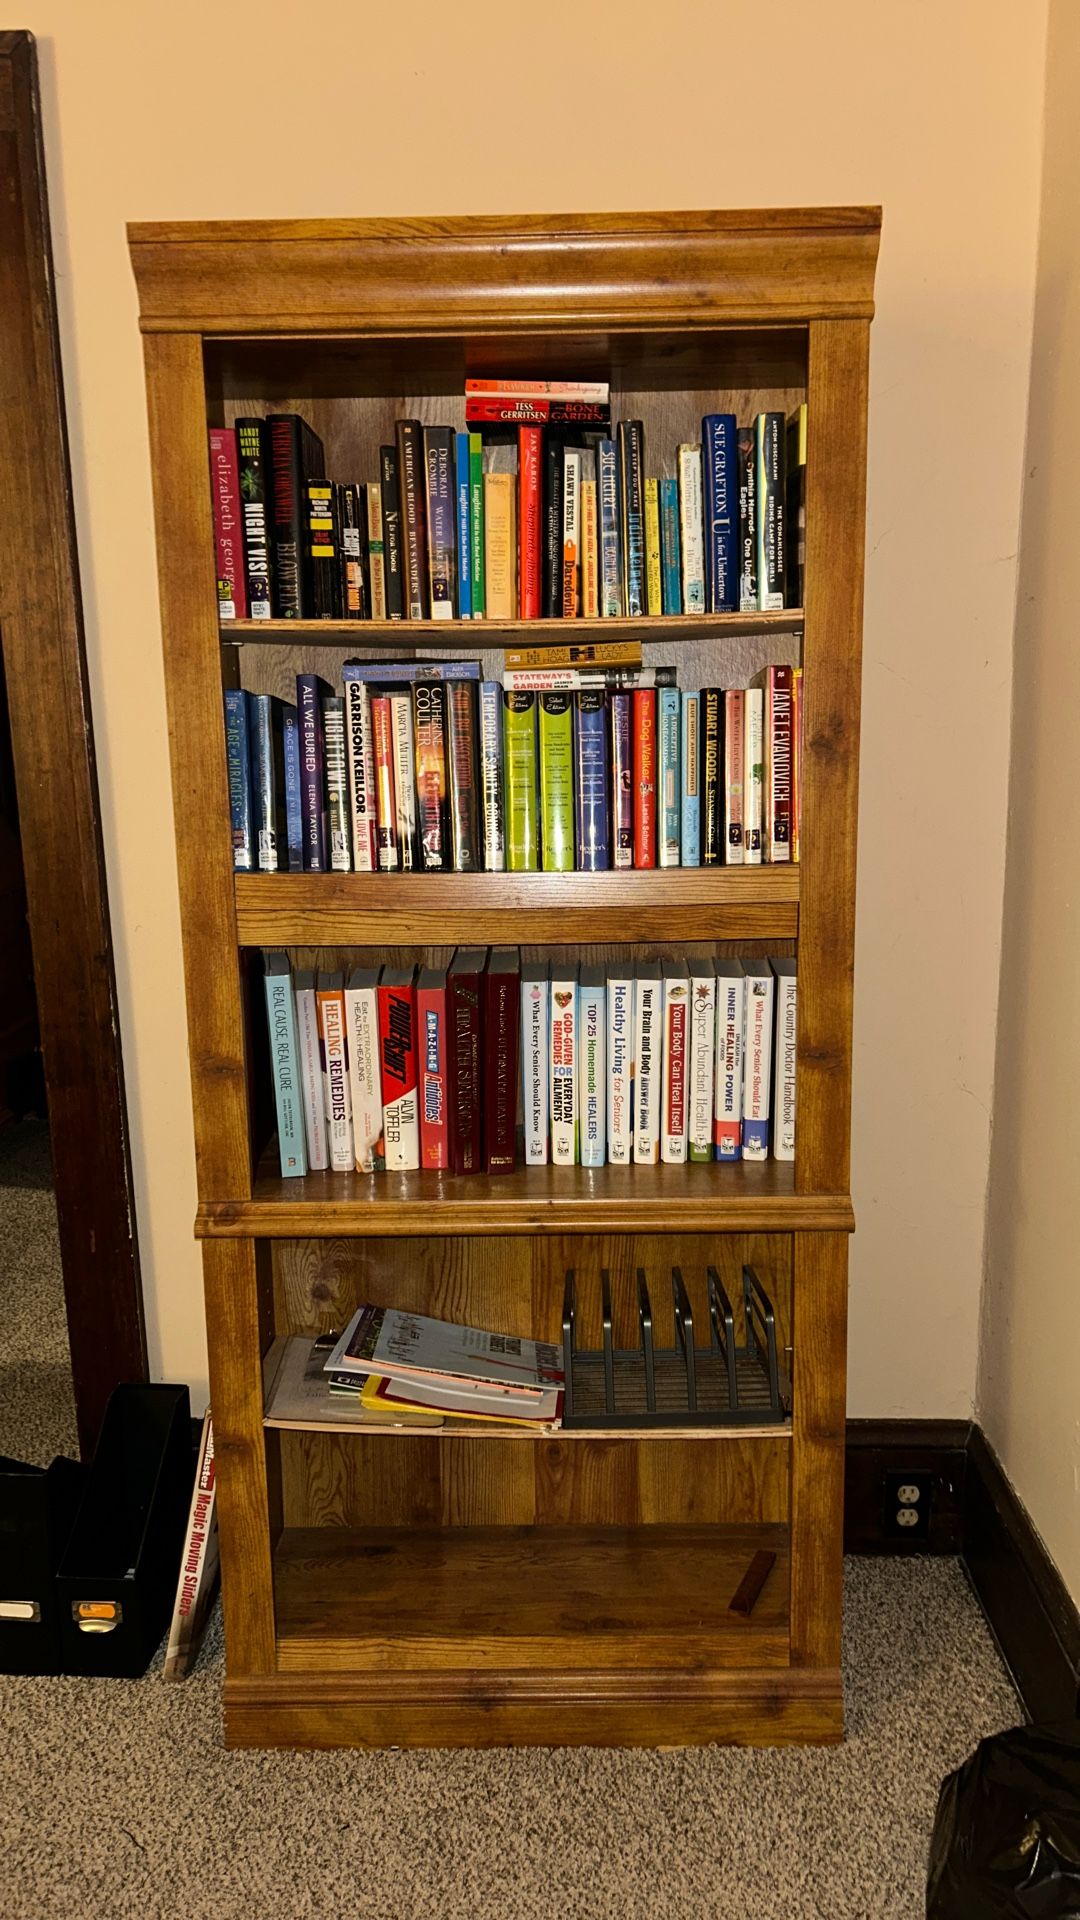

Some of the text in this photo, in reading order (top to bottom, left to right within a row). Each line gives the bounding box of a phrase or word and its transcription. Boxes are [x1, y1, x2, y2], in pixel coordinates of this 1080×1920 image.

[501, 411, 546, 419] GERRITSEN
[714, 423, 725, 449] SUE
[218, 455, 234, 530] elizabeth
[272, 422, 294, 524] PATRICIA CORNWELL
[429, 449, 438, 496] CROMBIE
[437, 448, 448, 498] DEBORAH
[603, 451, 616, 509] SUE HENRY
[715, 451, 727, 513] GRAFTON
[245, 503, 265, 544] NIGHT
[405, 440, 419, 593] AMERICAN BLOOD BEN SANDERS
[435, 506, 444, 536] WATER
[459, 484, 468, 517] Laughter
[473, 485, 481, 517] Laughter
[711, 517, 731, 534] U
[740, 486, 748, 519] Eagles
[747, 498, 755, 534] Harrod-
[386, 511, 398, 572] N NOOSE
[564, 465, 575, 616] SHAWN VESTAL Daredevils
[629, 512, 642, 547] Judith
[717, 544, 725, 556] for
[744, 538, 752, 558] One
[717, 557, 727, 600] Undertow
[416, 687, 431, 747] COULTER
[431, 687, 443, 746] CATHERINE
[640, 719, 651, 741] Dog
[641, 700, 649, 716] The
[286, 719, 294, 751] GRACE
[287, 753, 294, 763] IS
[324, 710, 346, 791] NIGHTTOWN
[397, 702, 409, 775] MARCIA MULLER
[483, 691, 497, 795] TEMPORARY SANITY
[641, 743, 651, 779] Walker
[706, 693, 717, 783] STUART WOODS
[773, 688, 790, 801] JANET EVANOVICH
[227, 728, 241, 807] AGE MIRACLES
[302, 685, 318, 845] ALL WE BURIED ELENA TAYLOR
[350, 682, 369, 852] GARRISON KEILLOR LOVE ME
[642, 826, 650, 850] Schnur
[272, 986, 286, 1010] REAL
[274, 1010, 288, 1041] CAUSE,
[325, 1003, 341, 1056] HEALING
[354, 1002, 365, 1082] HEALTH HEALING
[361, 1001, 373, 1096] Eat EXTRAORDINARY
[456, 1008, 471, 1067] HEALTH
[553, 1020, 563, 1065] REMEDIES
[563, 1013, 573, 1065] GOD-GIVEN
[725, 987, 736, 1112] INNER HEALING POWER
[277, 1043, 289, 1065] REAL
[279, 1067, 292, 1091] CURE
[530, 1001, 542, 1132] What Every Senior Should Know
[553, 1066, 573, 1076] FOR
[587, 1004, 597, 1140] TOP 25 Homemade HEALERS
[612, 985, 626, 1133] Healthy Living for Seniors
[640, 989, 653, 1130] Your Brain and Body Answer Book
[671, 1005, 683, 1134] Your Body Can Heal Itself
[694, 999, 713, 1132] Super Abundant Health
[752, 1000, 763, 1118] What Every Senior Should Eat
[783, 983, 796, 1125] The Country Doctor Handbook
[329, 1060, 345, 1121] REMEDIES
[401, 1099, 414, 1124] ALVIN
[424, 1073, 442, 1124] Antidotes!
[553, 1077, 563, 1122] AILMENTS
[563, 1077, 573, 1124] EVERYDAY
[386, 1105, 400, 1143] TOFFLER
[178, 1493, 211, 1617] Magic Moving Sliders
